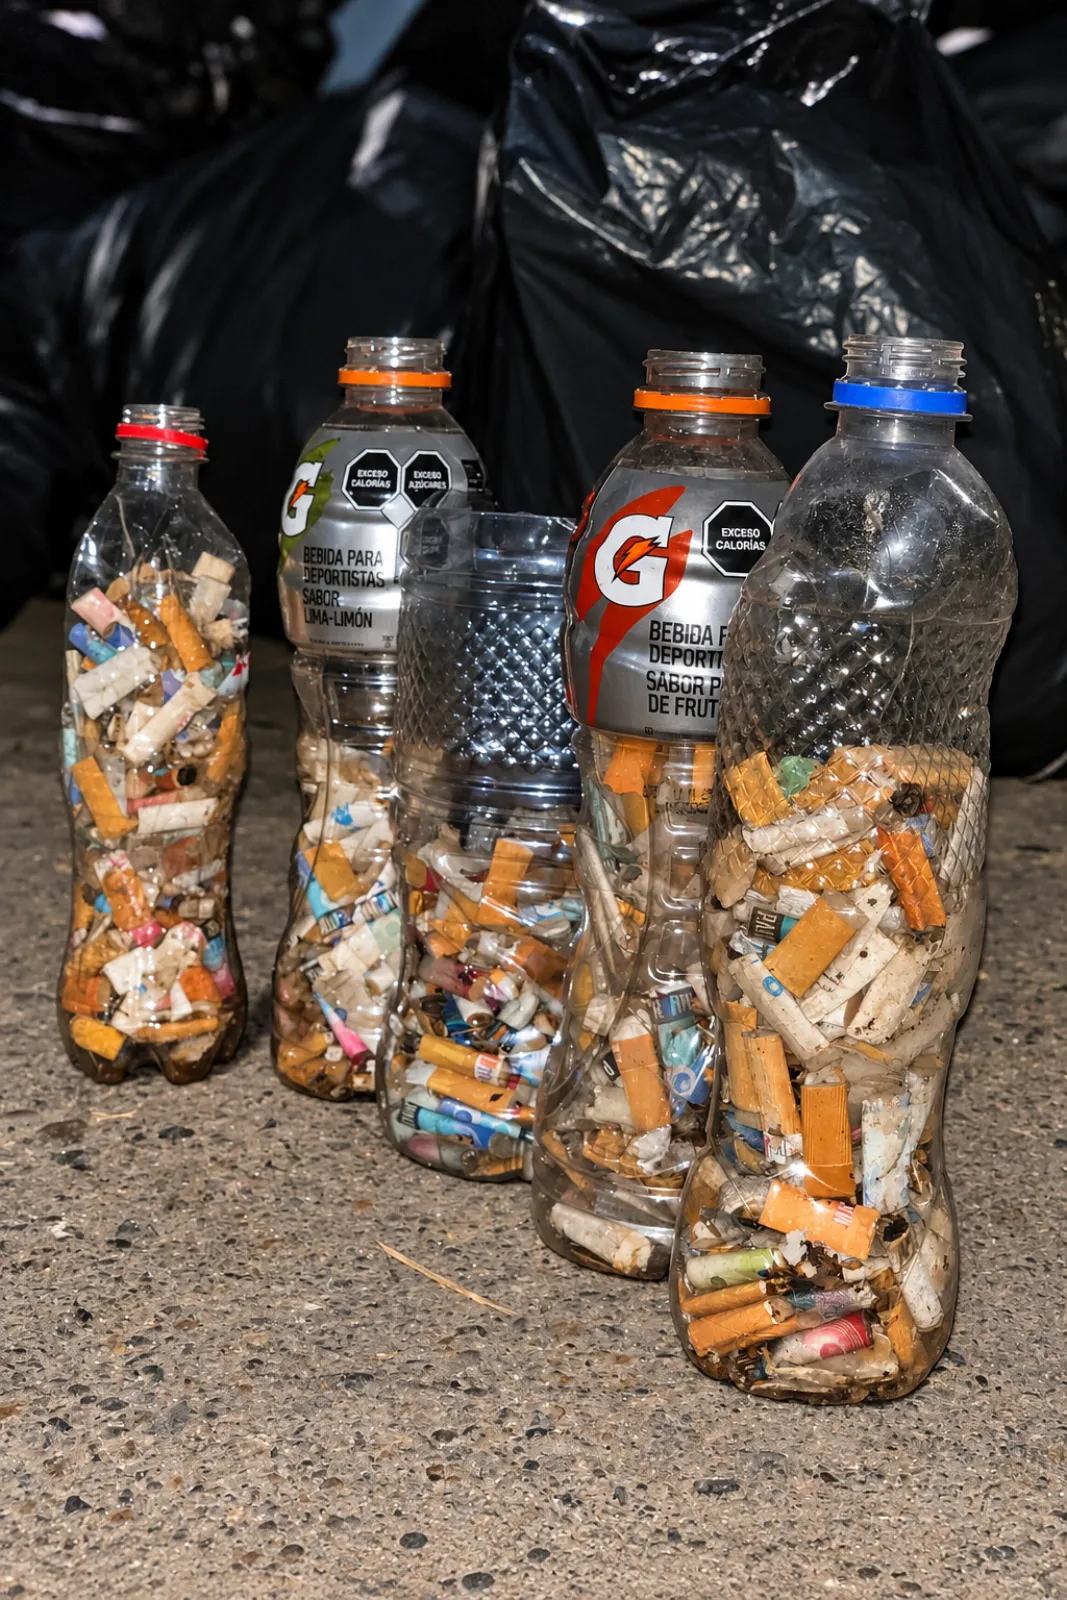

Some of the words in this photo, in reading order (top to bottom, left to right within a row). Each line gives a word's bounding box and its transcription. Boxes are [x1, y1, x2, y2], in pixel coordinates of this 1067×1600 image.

[351, 478, 391, 489] CALORÍAS
[357, 469, 389, 478] EXCESO
[413, 470, 442, 479] EXCESO
[408, 479, 447, 490] AZÚCARES
[721, 527, 761, 538] EXCESO
[715, 538, 767, 551] CALORÍAS
[303, 546, 344, 566] BEBIDA
[347, 549, 384, 567] PARA
[594, 514, 674, 608] G
[303, 567, 385, 588] DEPORTISTAS
[302, 587, 341, 607] SABOR
[303, 607, 373, 628] LIMA-LIMÓN
[649, 620, 714, 646] BEBIDA
[649, 643, 724, 669] DEPORTI
[646, 670, 705, 696] SABOR
[648, 693, 670, 715] DE
[674, 696, 719, 718] FRUT
